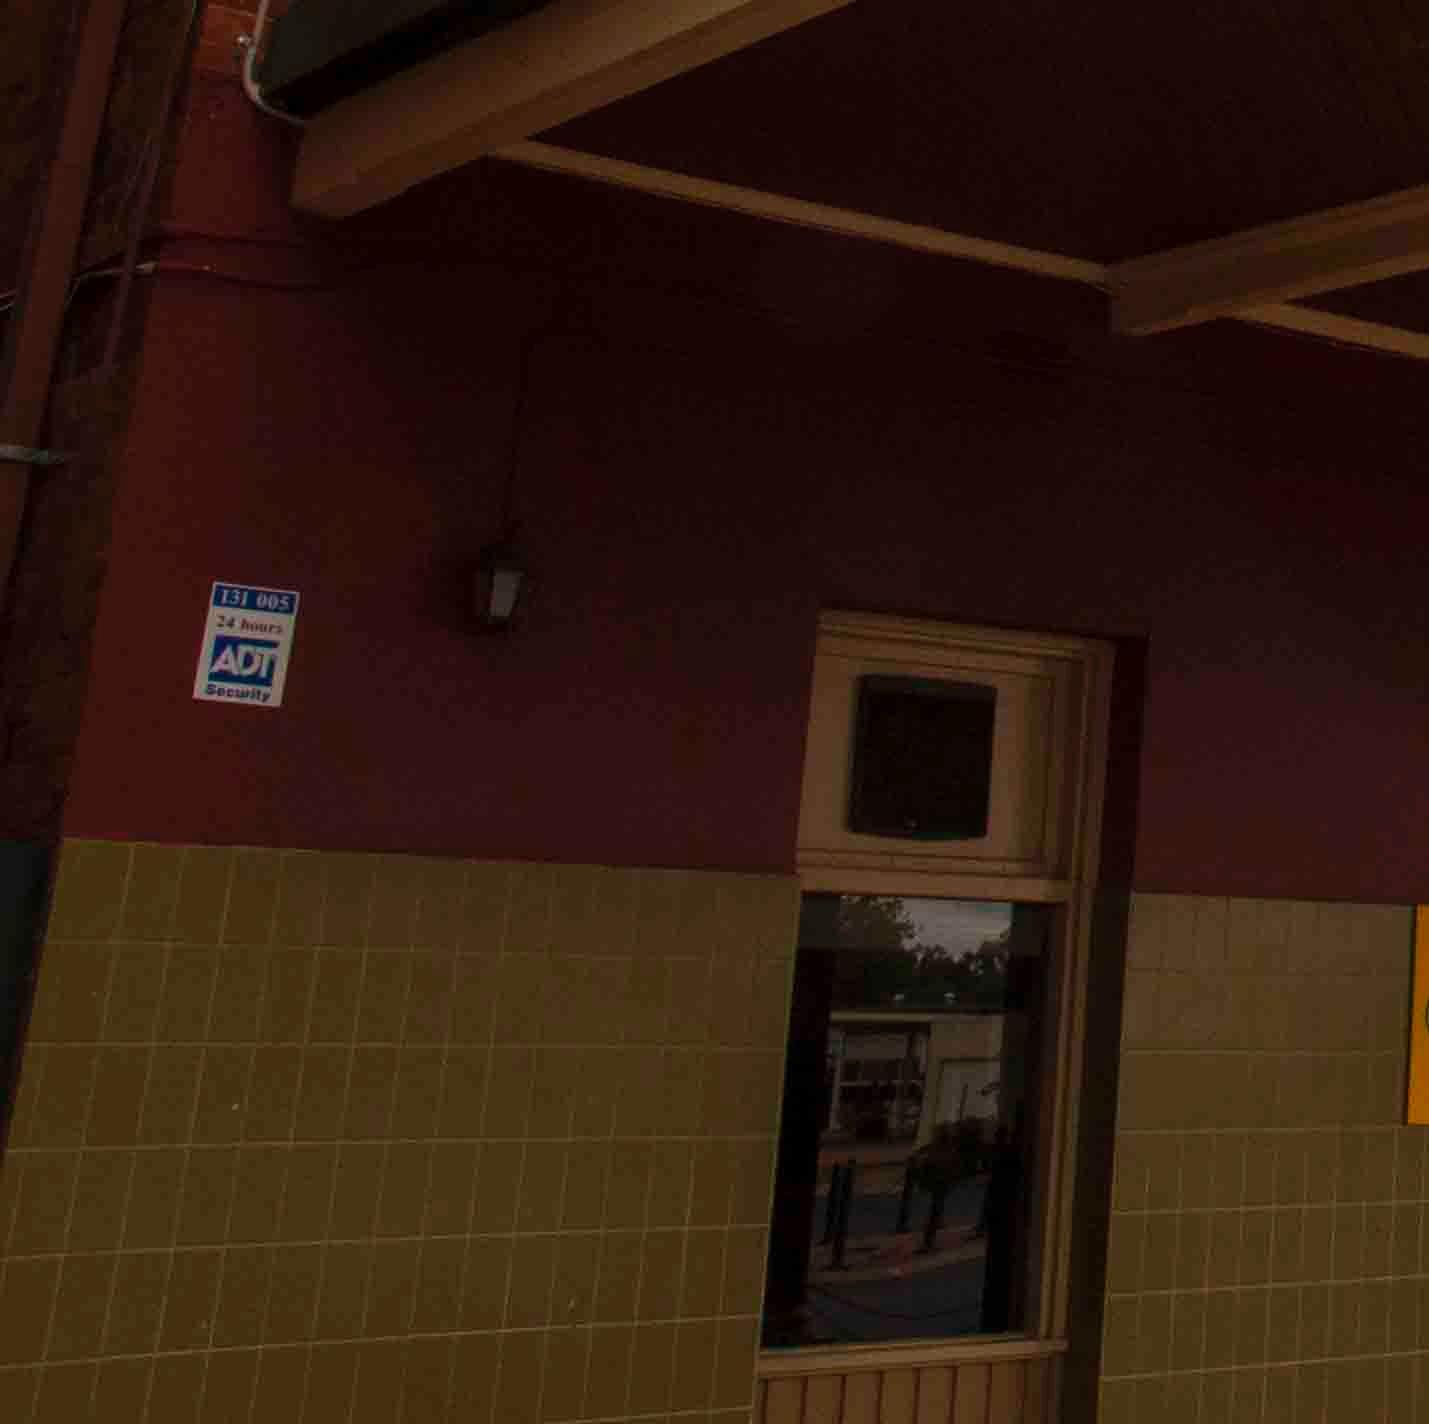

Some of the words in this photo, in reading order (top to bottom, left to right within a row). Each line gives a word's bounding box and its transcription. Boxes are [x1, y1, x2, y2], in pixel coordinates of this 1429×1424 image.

[221, 589, 248, 606] 131
[216, 616, 236, 628] 24
[240, 618, 283, 633] hours
[210, 643, 278, 679] ADT
[206, 683, 271, 703] Security
